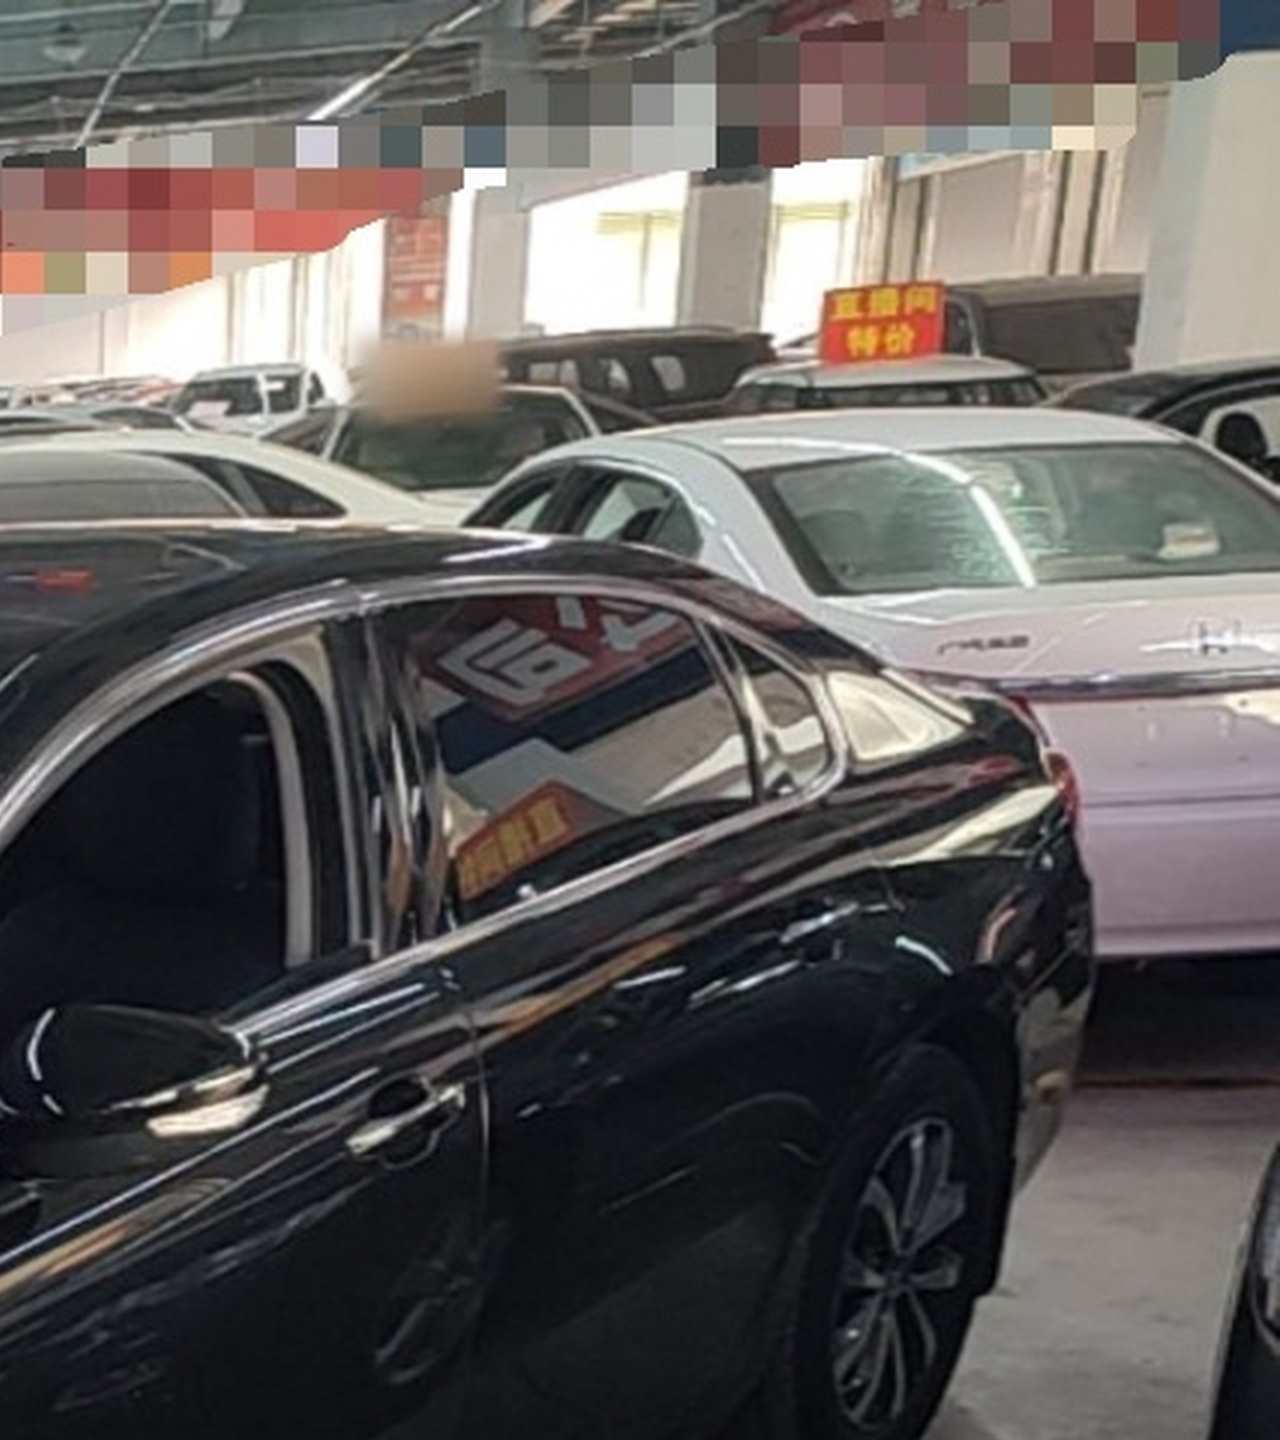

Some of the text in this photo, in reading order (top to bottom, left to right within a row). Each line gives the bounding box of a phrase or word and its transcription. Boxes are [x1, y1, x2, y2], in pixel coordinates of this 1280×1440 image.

[830, 286, 937, 319] 直播间
[847, 322, 916, 358] 特价
